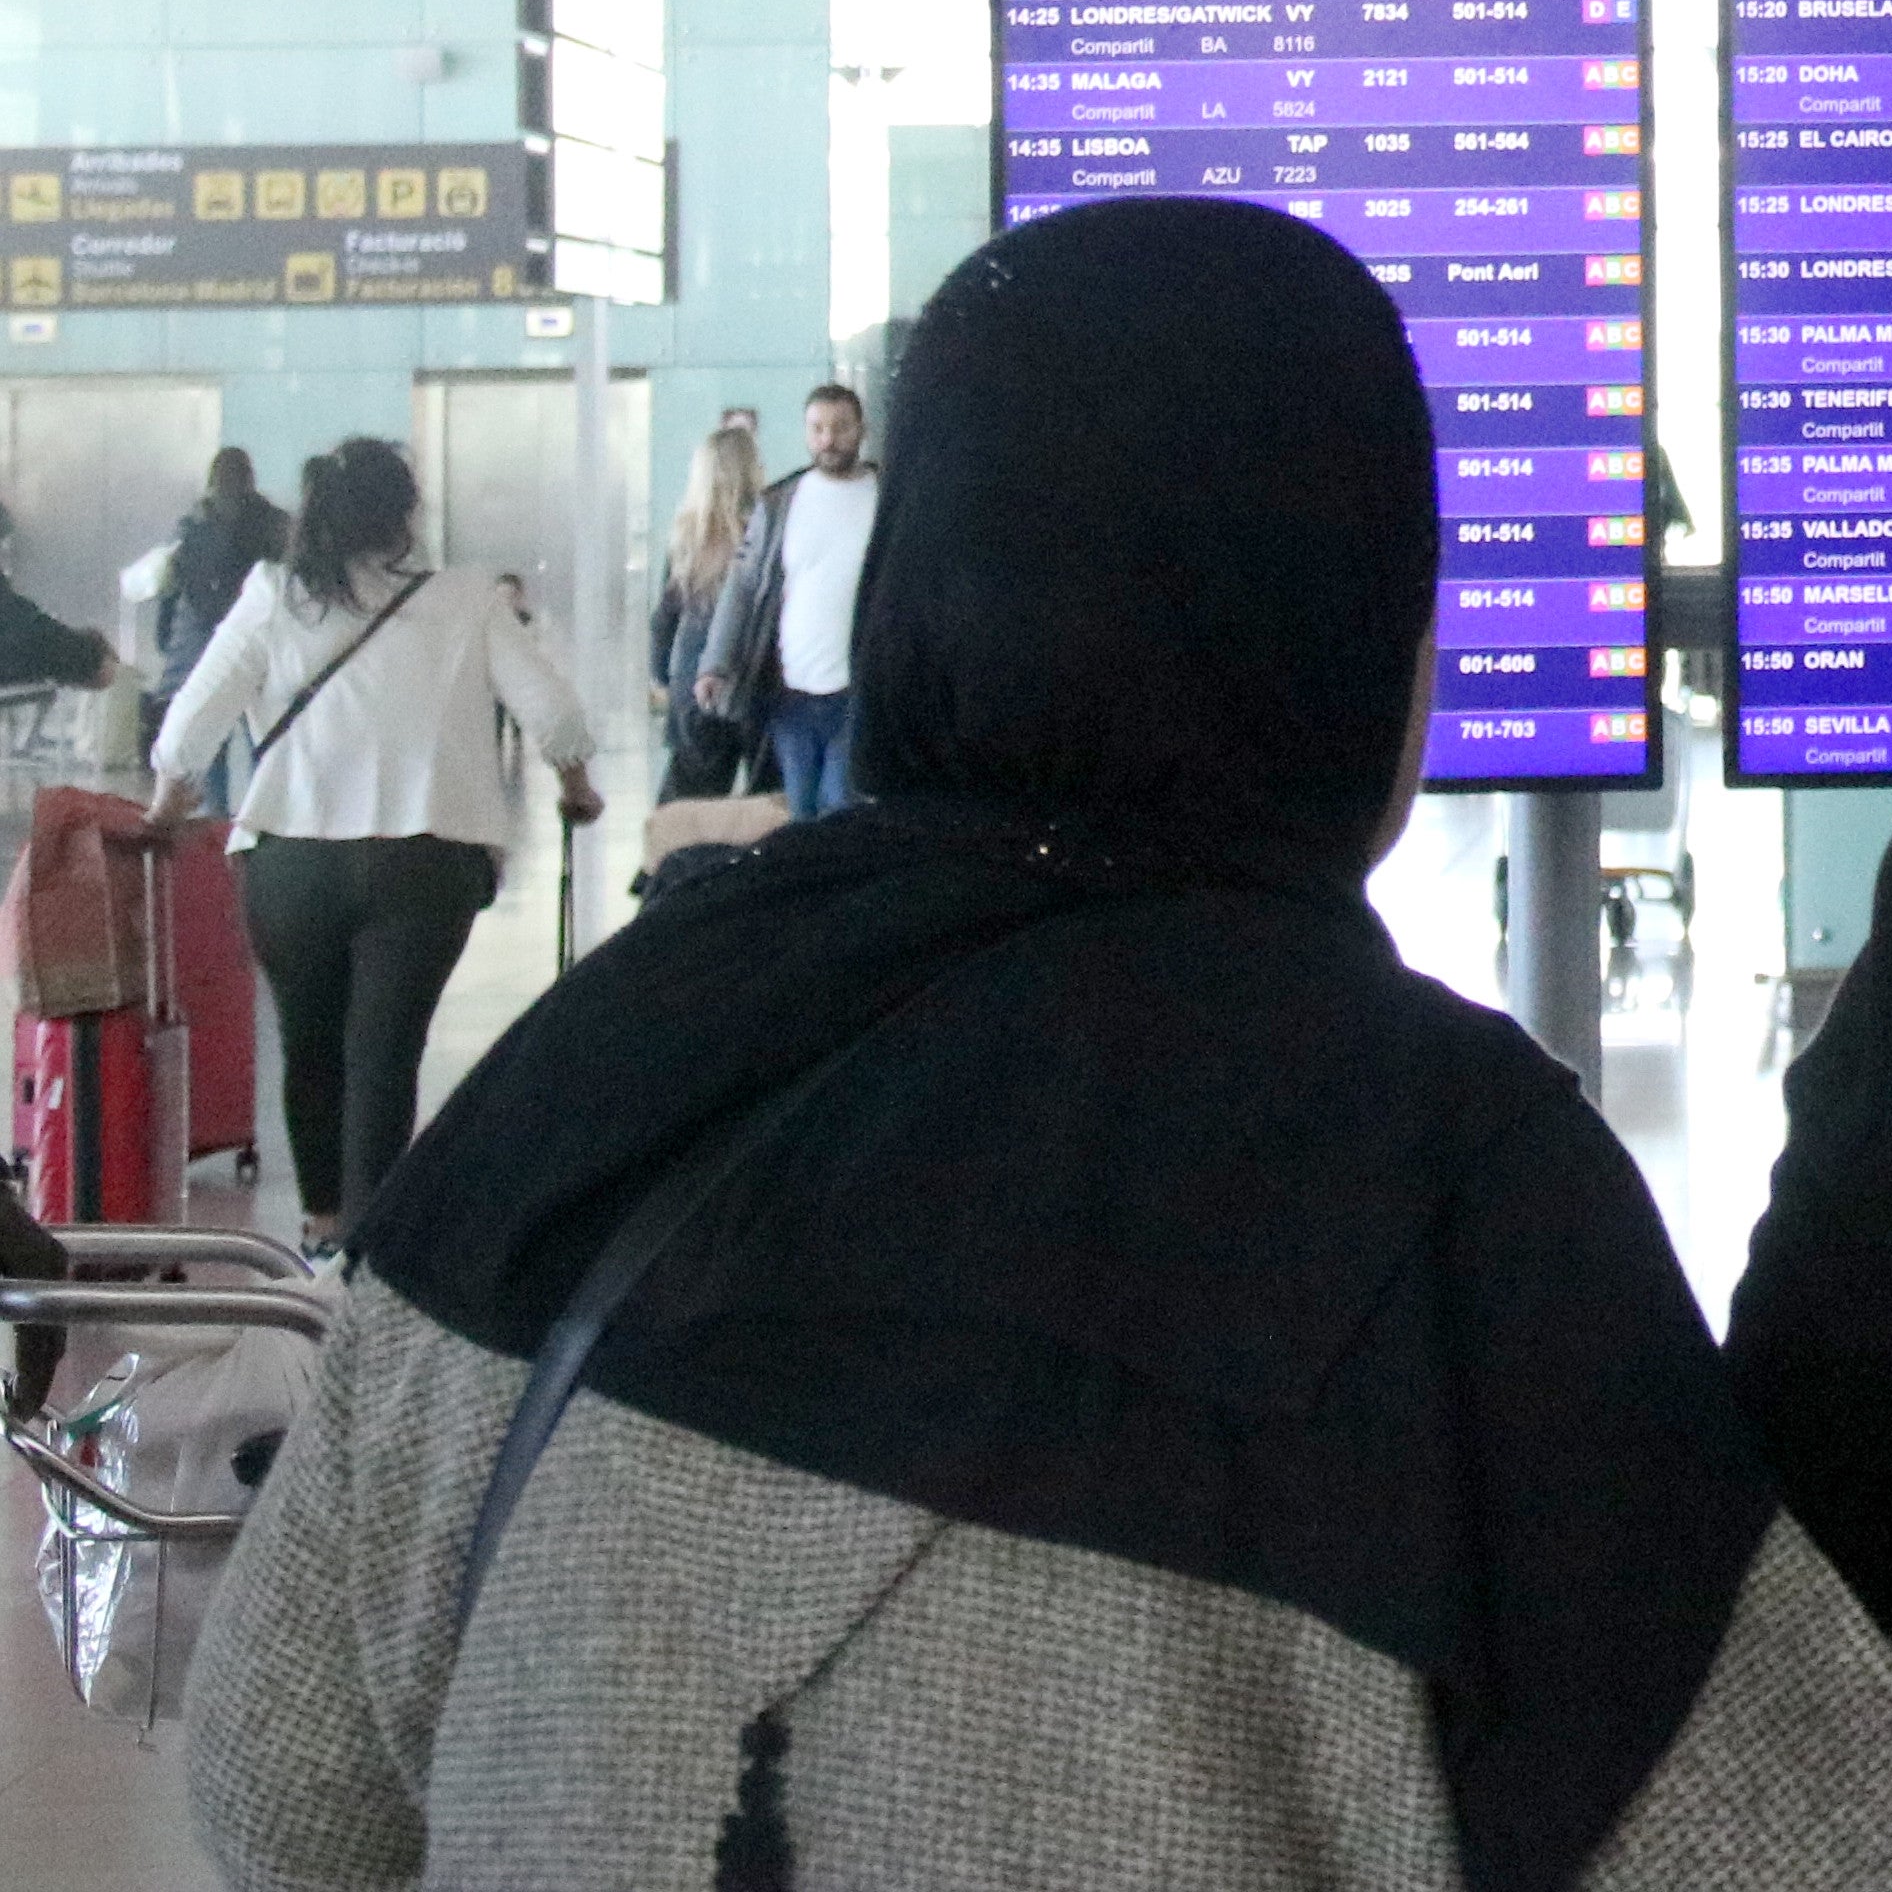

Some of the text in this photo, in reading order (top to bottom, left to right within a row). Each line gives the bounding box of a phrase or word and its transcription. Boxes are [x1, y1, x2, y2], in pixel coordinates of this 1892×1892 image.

[1009, 132, 1529, 156] 14:35 LISBOA TAP 1035 561-564
[1742, 651, 1794, 669] 15:50
[1804, 650, 1864, 669] ORAN
[1460, 720, 1536, 738] 701-703
